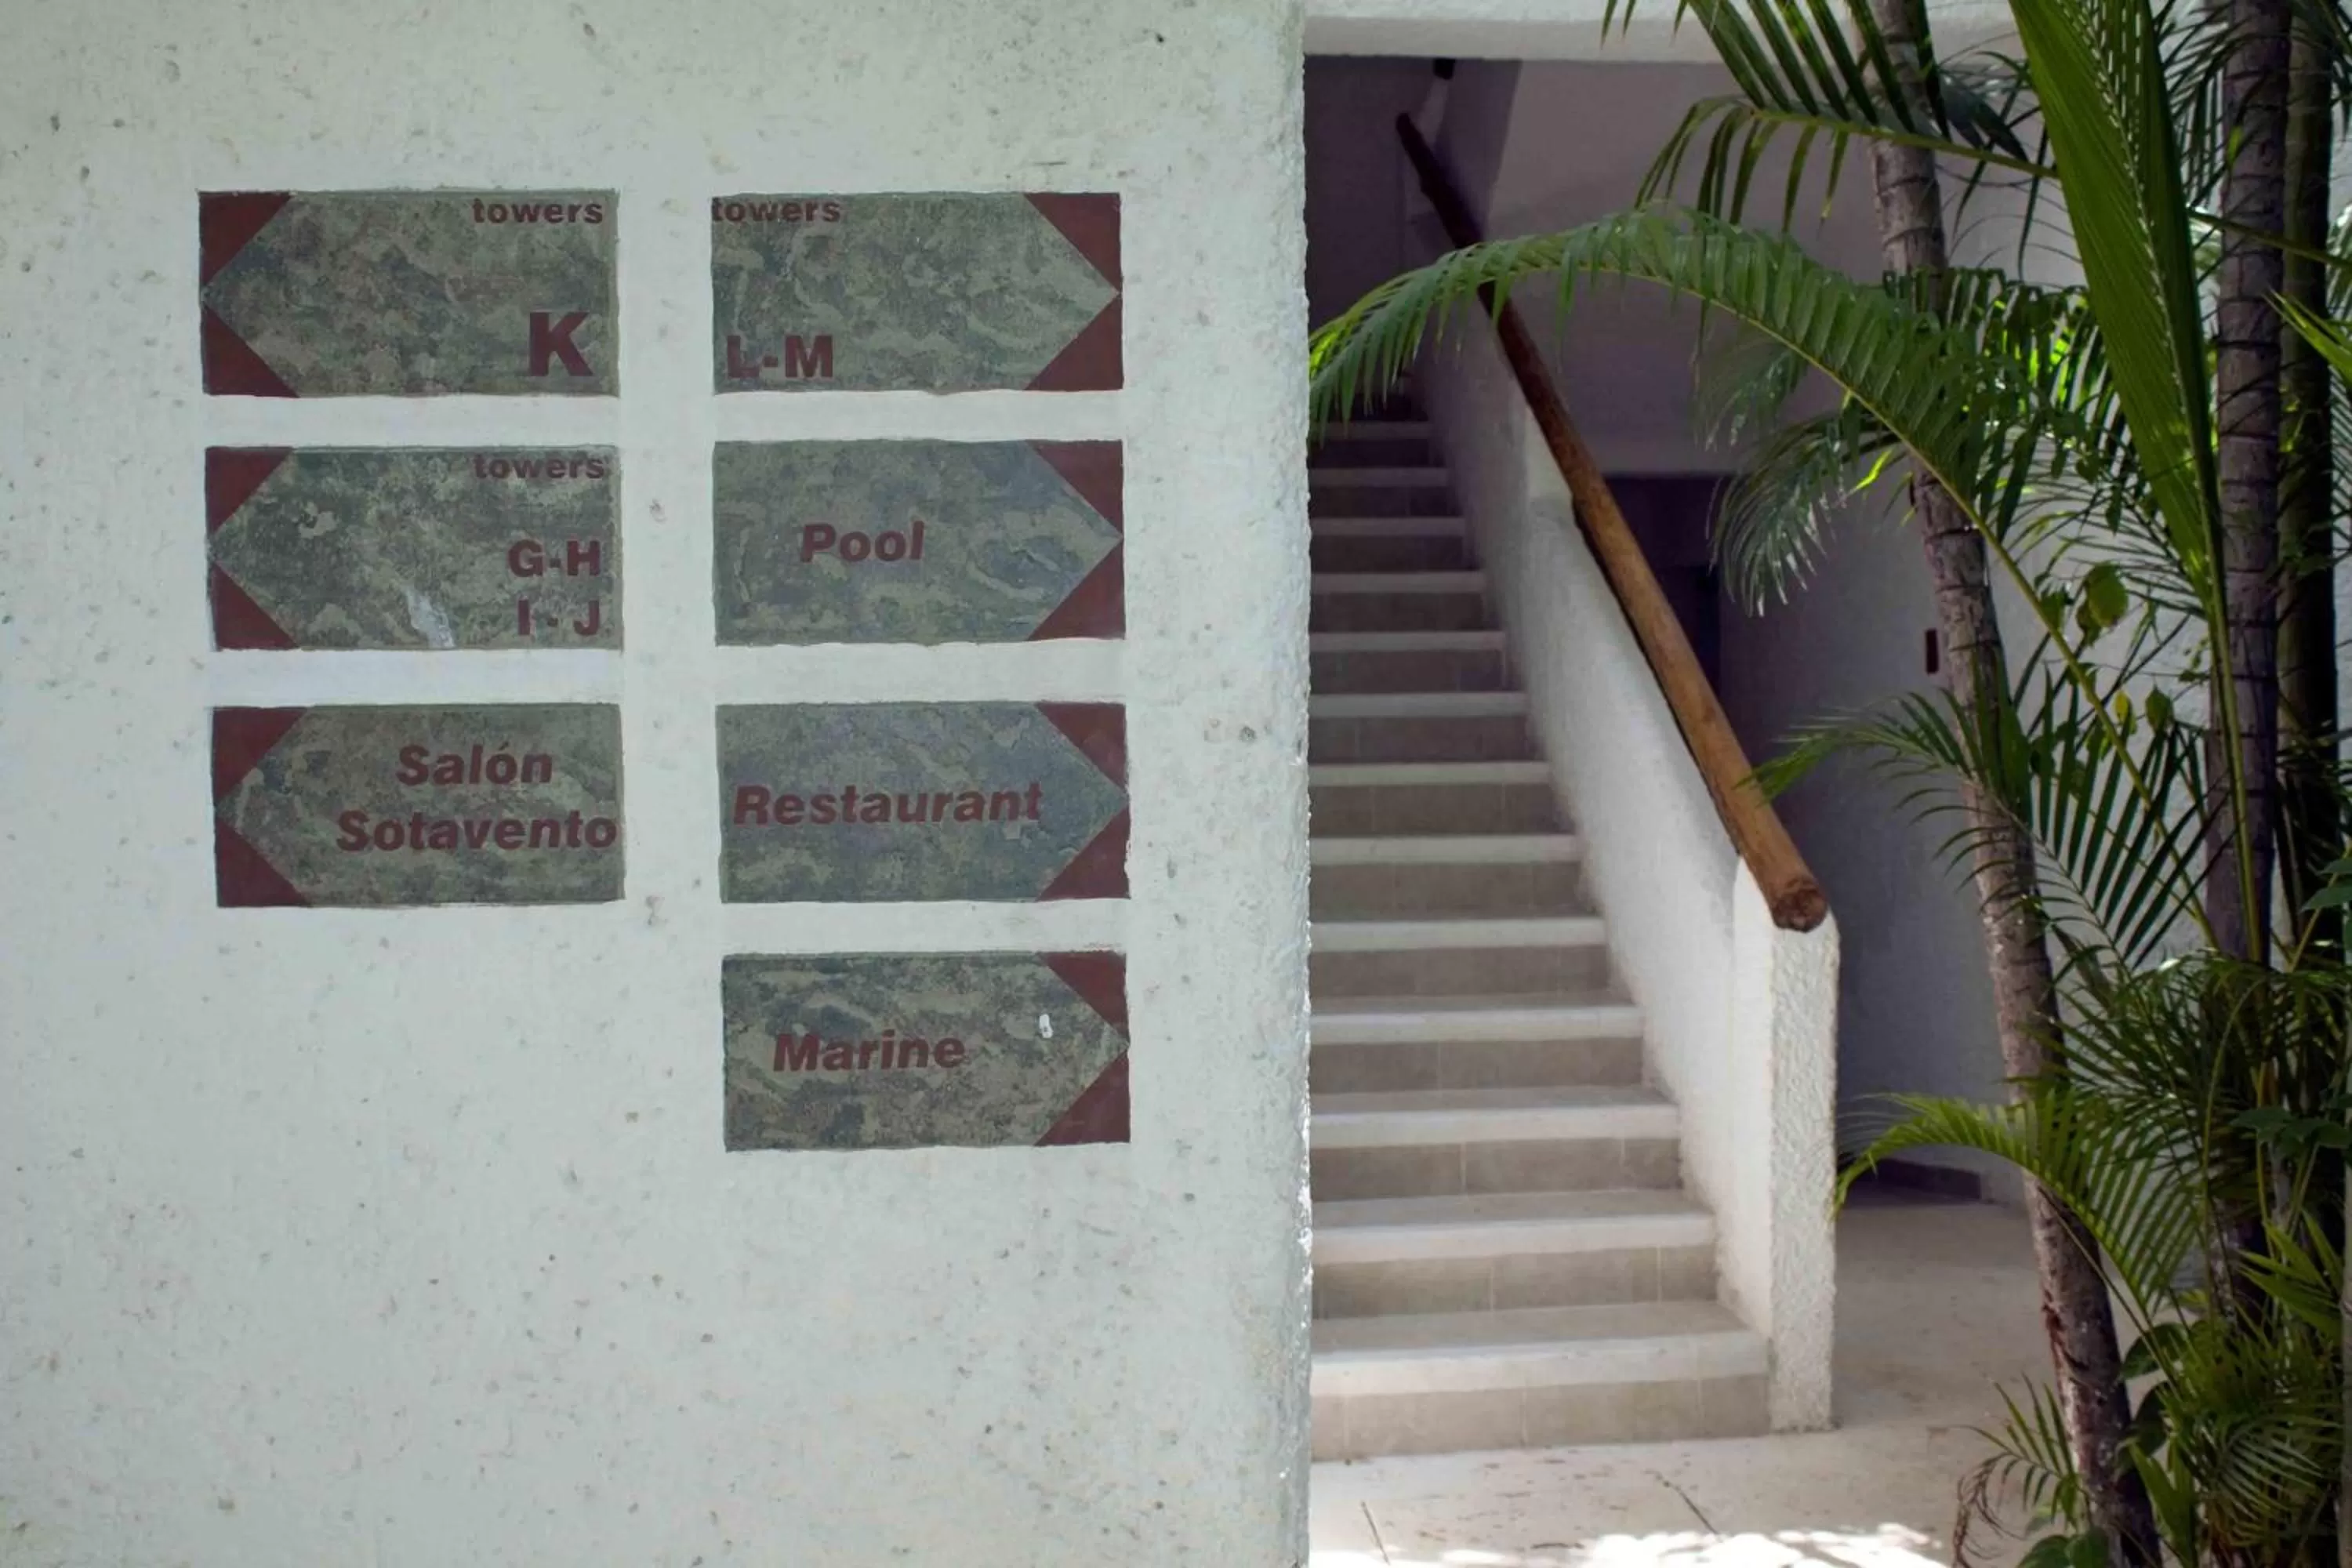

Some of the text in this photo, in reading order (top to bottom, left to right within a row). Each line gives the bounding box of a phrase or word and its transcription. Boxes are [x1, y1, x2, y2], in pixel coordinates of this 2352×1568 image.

[474, 198, 604, 224] towers
[711, 198, 841, 222] towers
[529, 312, 594, 376] K
[726, 336, 833, 378] L-M
[474, 454, 605, 479] towers
[508, 539, 601, 578] G-H
[800, 521, 925, 563] Pool
[517, 600, 601, 637] I-J
[396, 741, 554, 786] Salón
[733, 782, 1042, 826] Restaurant
[336, 809, 619, 852] Sotavento
[772, 1029, 965, 1073] Marine
